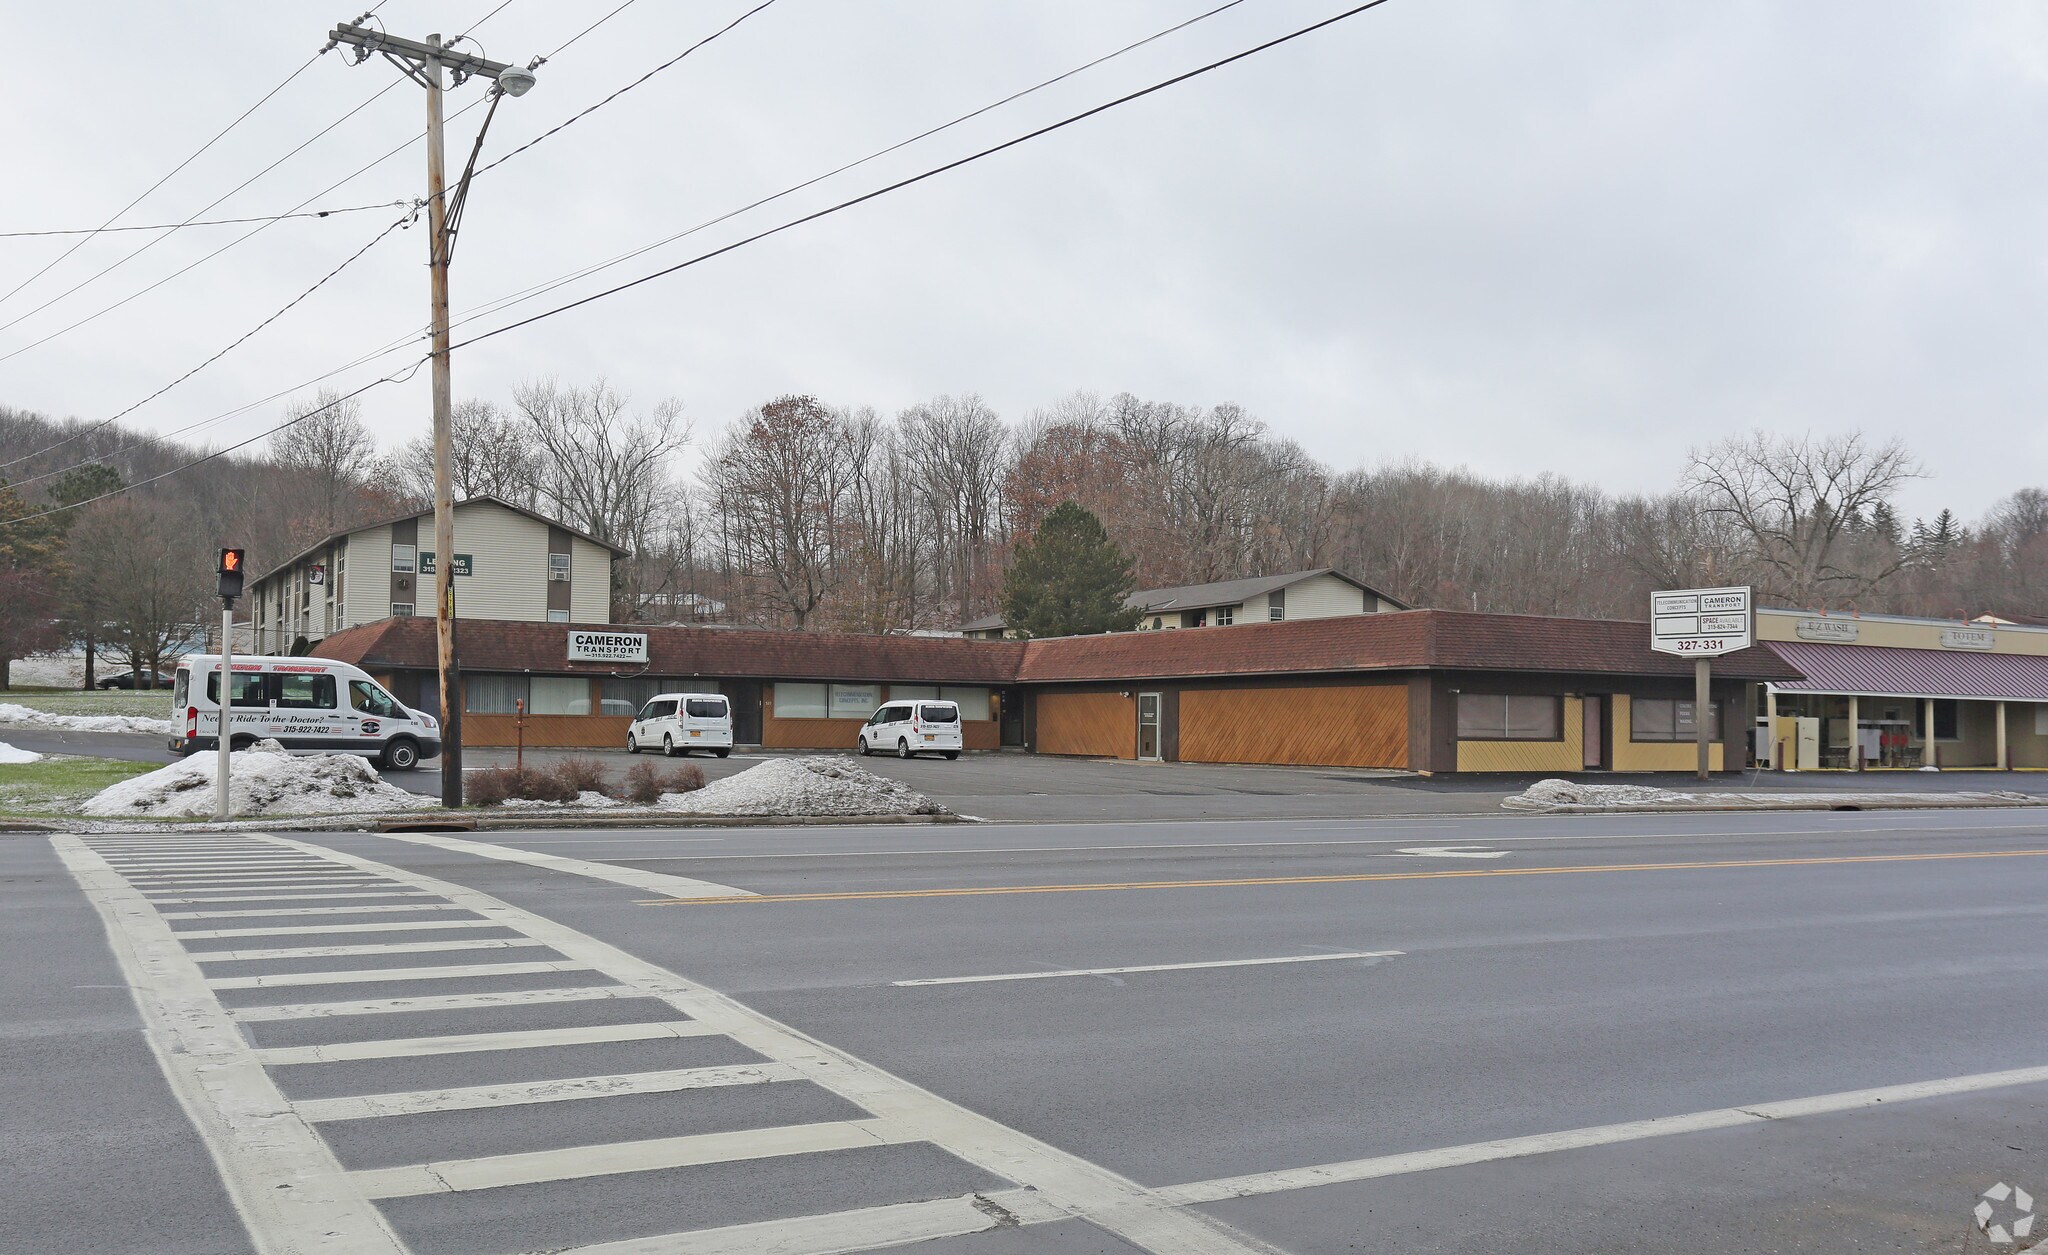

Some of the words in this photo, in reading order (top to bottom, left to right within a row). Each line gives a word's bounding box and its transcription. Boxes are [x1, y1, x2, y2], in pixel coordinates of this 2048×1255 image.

[426, 557, 466, 567] LENG
[1704, 596, 1741, 604] CAMERON
[575, 635, 642, 647] CAMERON
[1677, 639, 1723, 650] 327-331
[576, 645, 641, 654] TRANSPORT
[214, 663, 263, 671] CMERON
[272, 665, 328, 673] TRANSPORT
[202, 713, 221, 723] Nee
[236, 714, 257, 723] Ride
[260, 714, 270, 723] To
[272, 715, 287, 723] the
[289, 715, 325, 724] Doctor?
[283, 725, 330, 734] 315-922-7422
